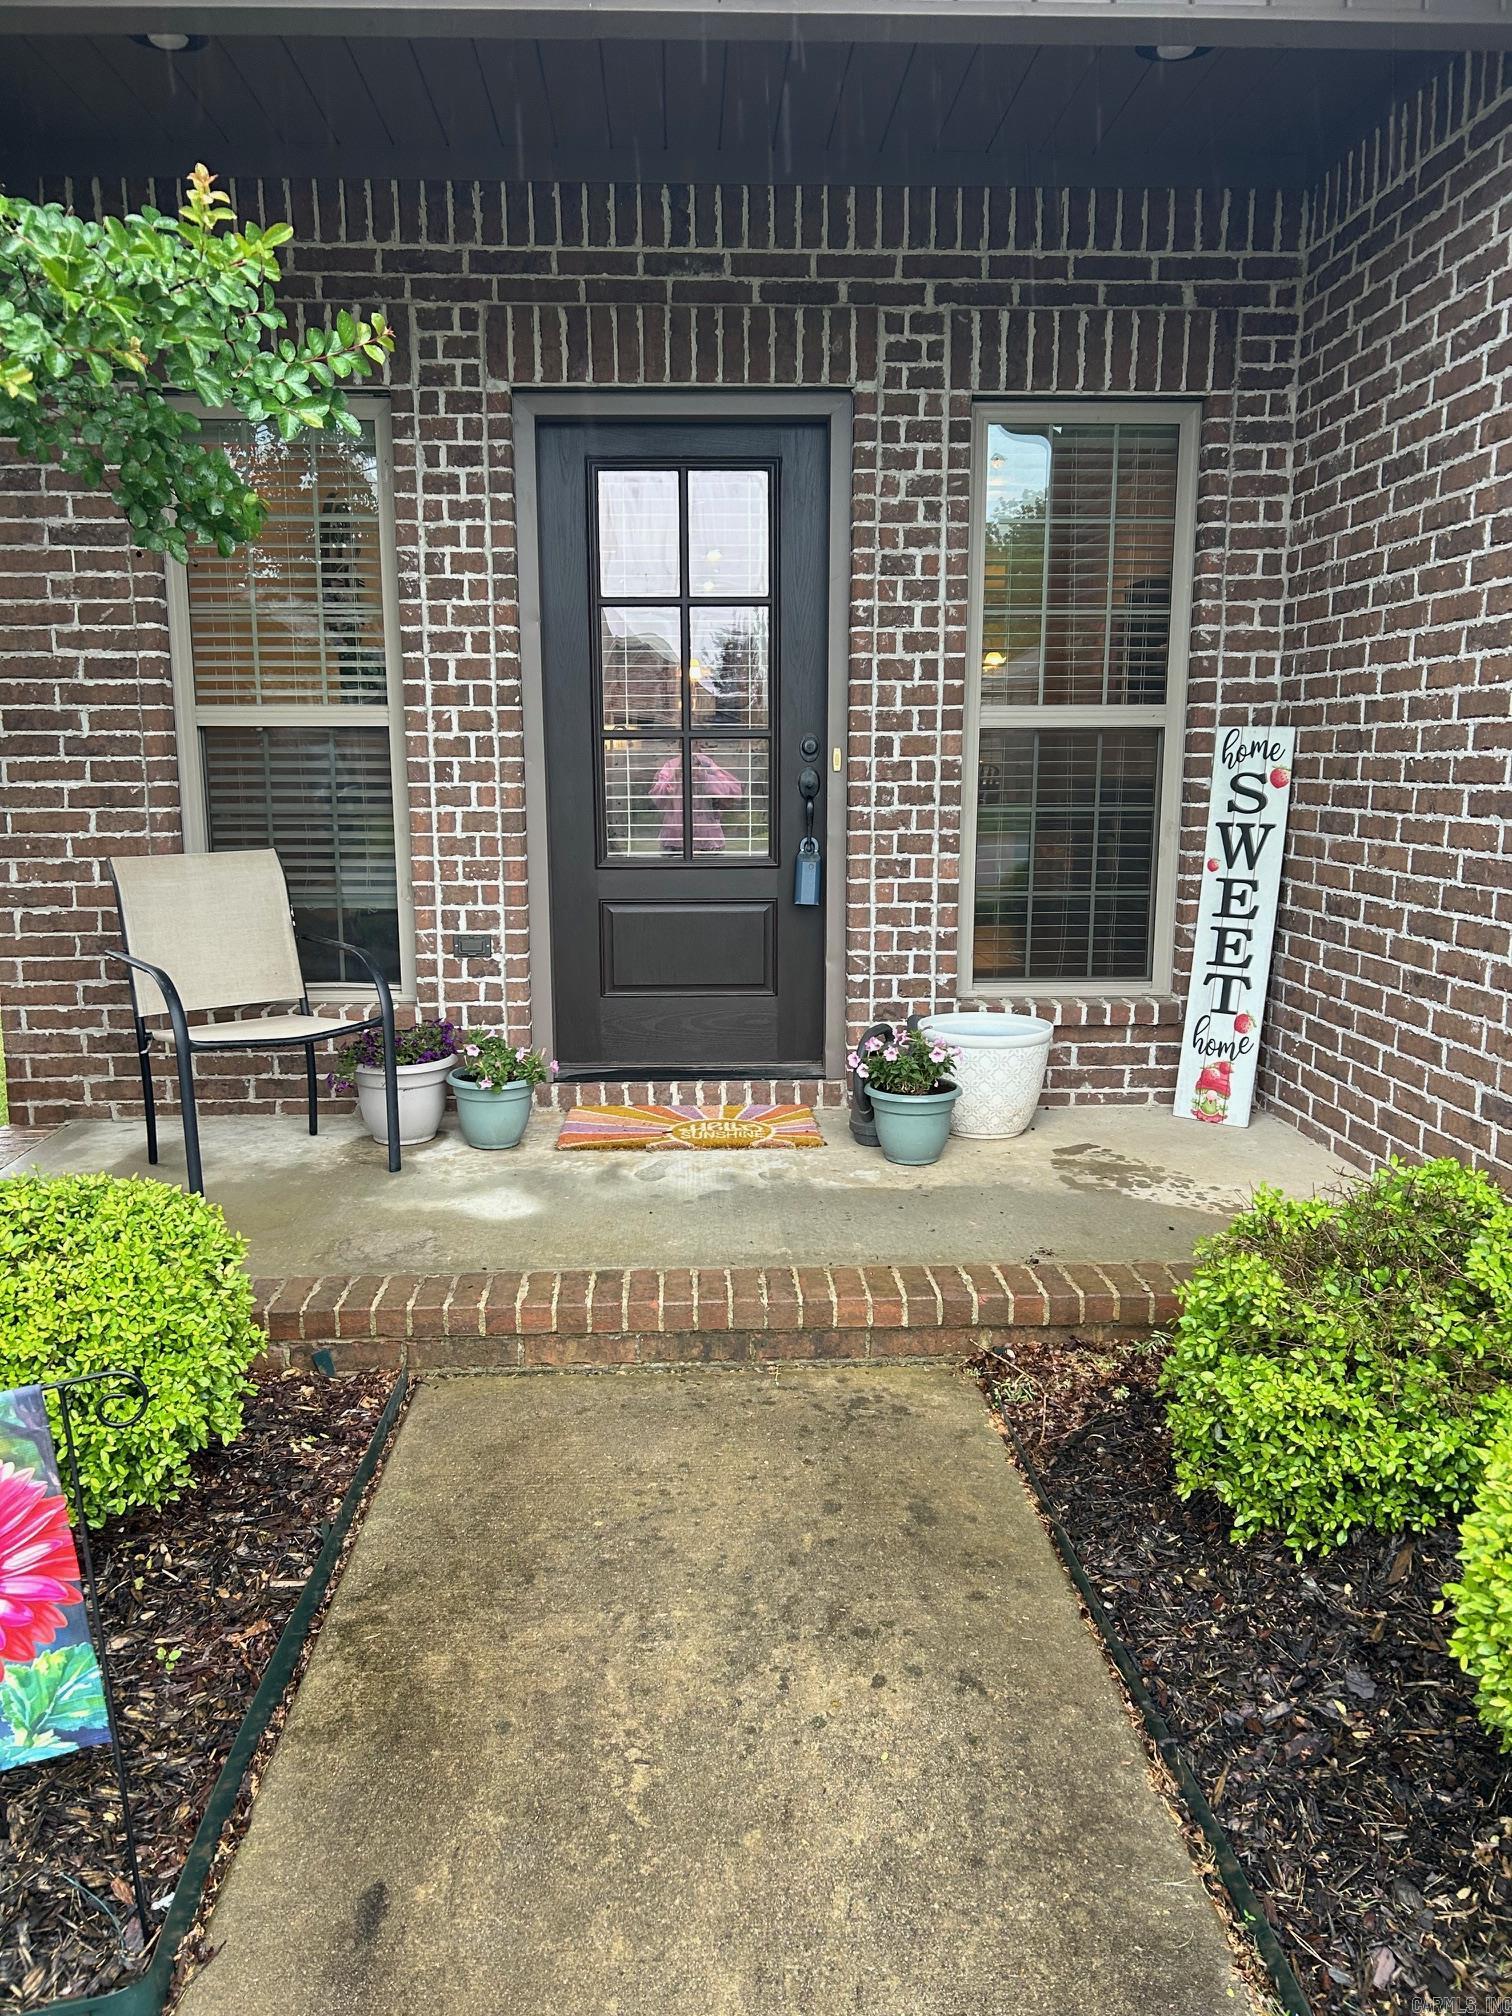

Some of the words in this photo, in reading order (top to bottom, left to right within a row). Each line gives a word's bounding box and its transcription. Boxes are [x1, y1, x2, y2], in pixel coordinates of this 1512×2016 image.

[1222, 728, 1286, 770] home
[1203, 772, 1276, 1015] SWEET
[1193, 1014, 1255, 1061] home
[680, 1129, 765, 1139] SUNSHINE
